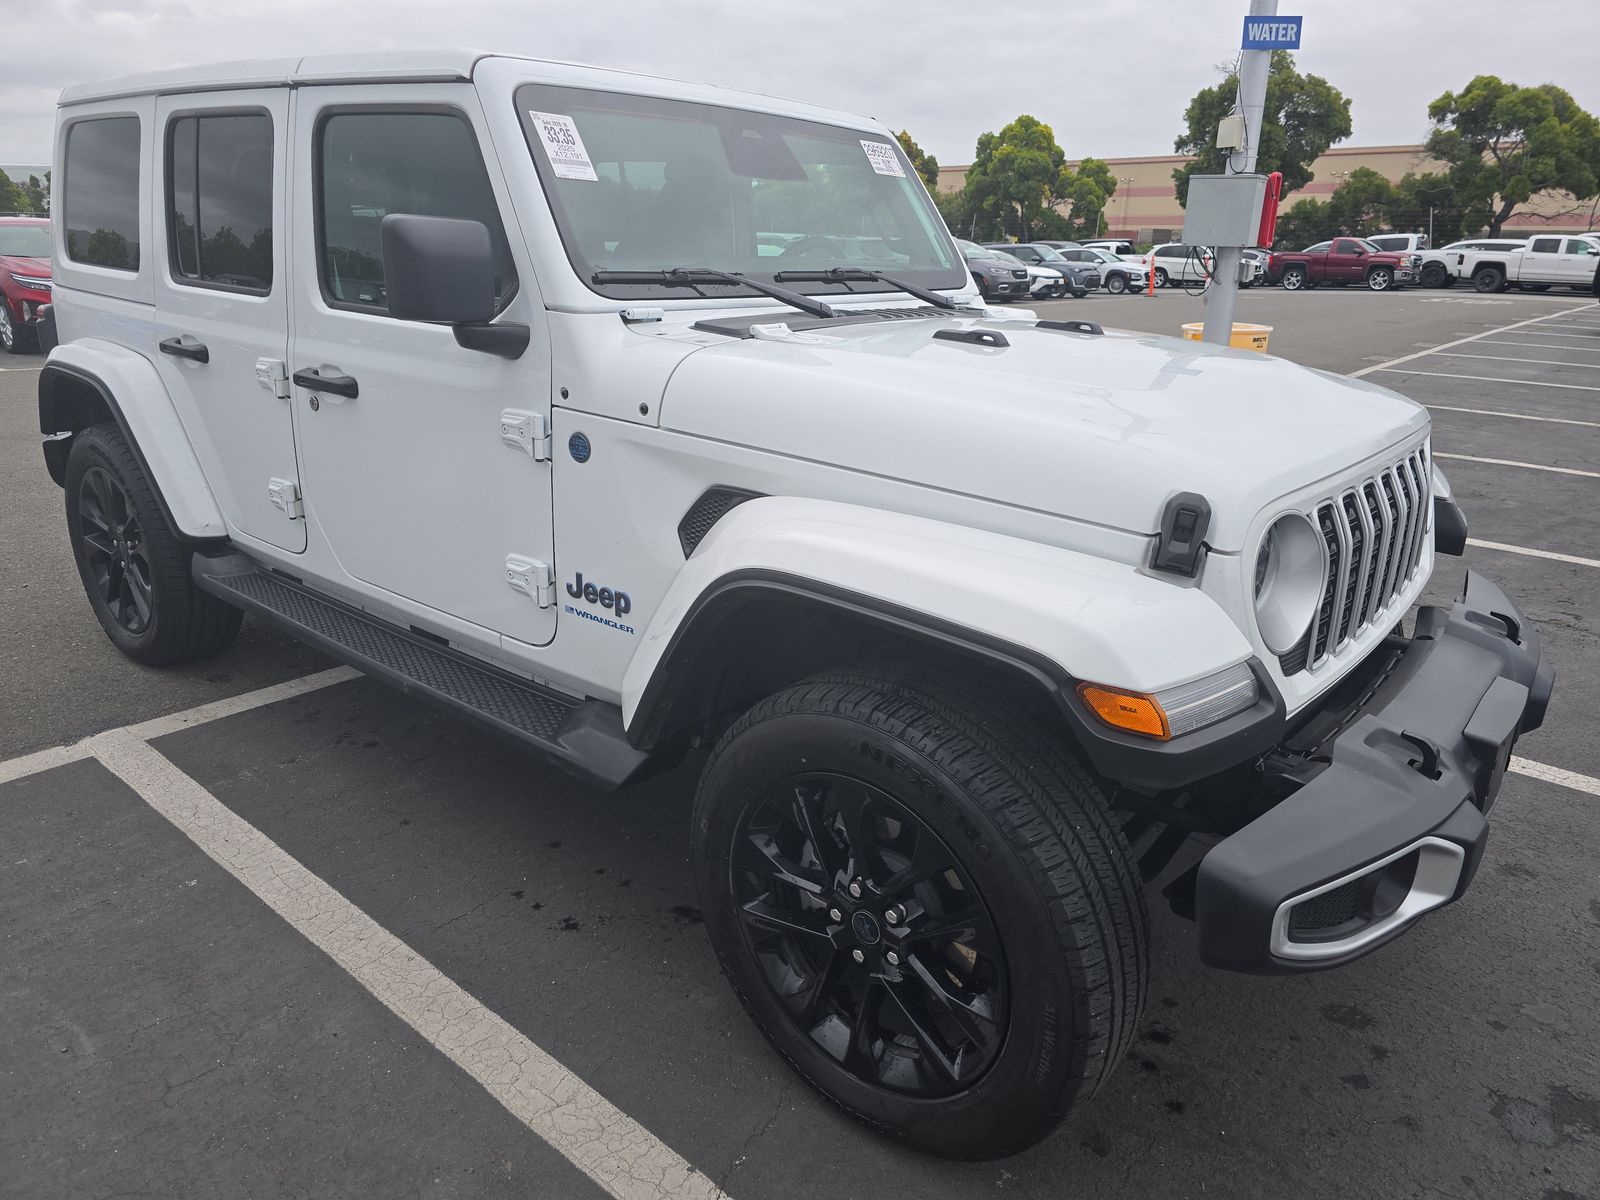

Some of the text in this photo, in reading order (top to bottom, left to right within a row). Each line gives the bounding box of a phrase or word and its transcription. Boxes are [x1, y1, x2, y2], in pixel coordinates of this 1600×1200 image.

[1248, 23, 1297, 42] WATER
[544, 126, 576, 145] 33:35
[556, 144, 576, 152] 2025
[566, 571, 632, 618] Jeep
[573, 608, 635, 635] WRANGLER
